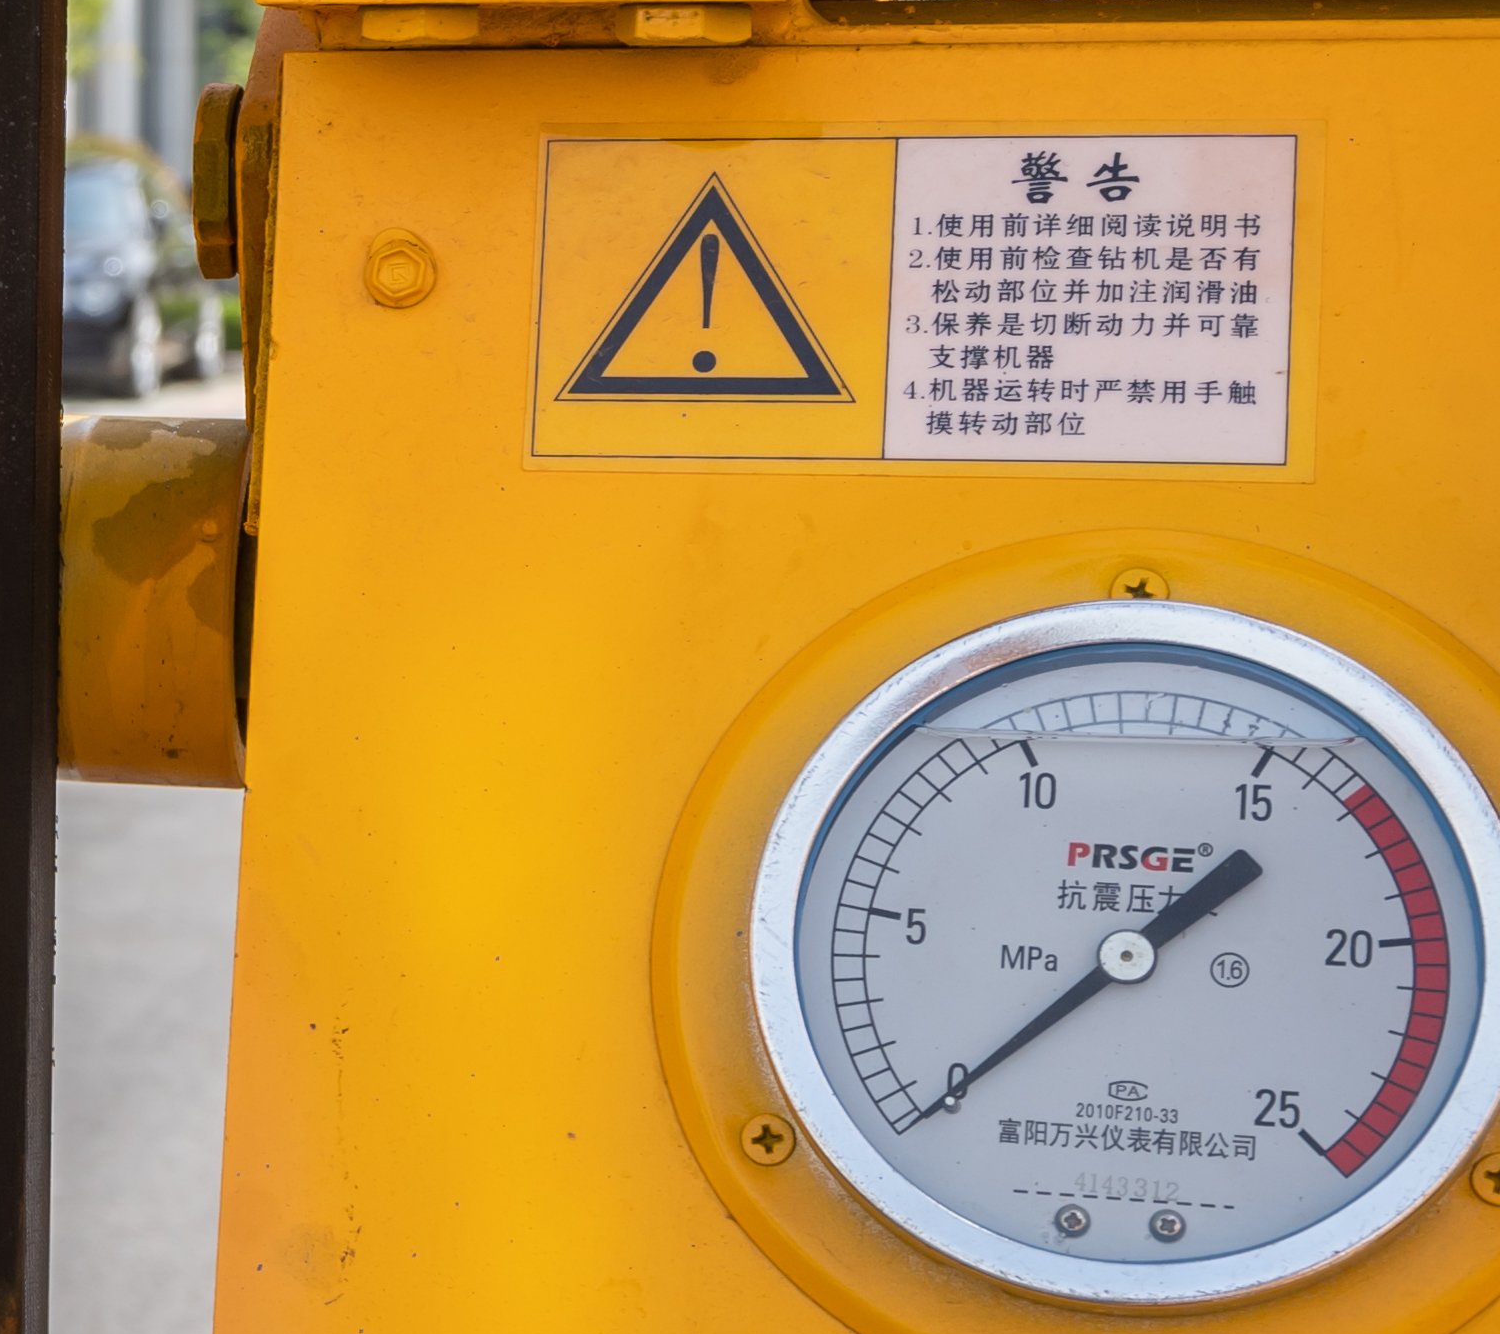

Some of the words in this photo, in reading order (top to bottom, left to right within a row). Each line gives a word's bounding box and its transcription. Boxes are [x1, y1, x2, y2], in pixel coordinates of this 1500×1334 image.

[1011, 150, 1140, 205] 警告
[912, 212, 1261, 238] 1.使用前详细阅读说明书
[909, 246, 1261, 272] 2.使用前检查钻机是否有
[931, 279, 1258, 305] 松动部位并加注润滑油
[905, 312, 1259, 338] 3.保养是切断动力并可靠
[928, 345, 1054, 370] 支撑机器
[903, 378, 1257, 406] 4.机器运转时严禁用手触
[926, 411, 1086, 436] 摸转动部位
[1019, 772, 1057, 810] 10
[1235, 783, 1274, 823] 15
[1057, 878, 1218, 916] 抗震压力
[904, 908, 928, 946] 5
[1324, 928, 1374, 969] 20
[1000, 943, 1058, 972] MPa
[1215, 959, 1244, 981] 1.6
[946, 1063, 969, 1101] 0
[1254, 1088, 1301, 1130] 25
[1075, 1102, 1179, 1124] 2010F210-33
[997, 1117, 1257, 1161] 富阳万兴仪表有限公司
[1074, 1170, 1180, 1203] 4143312
